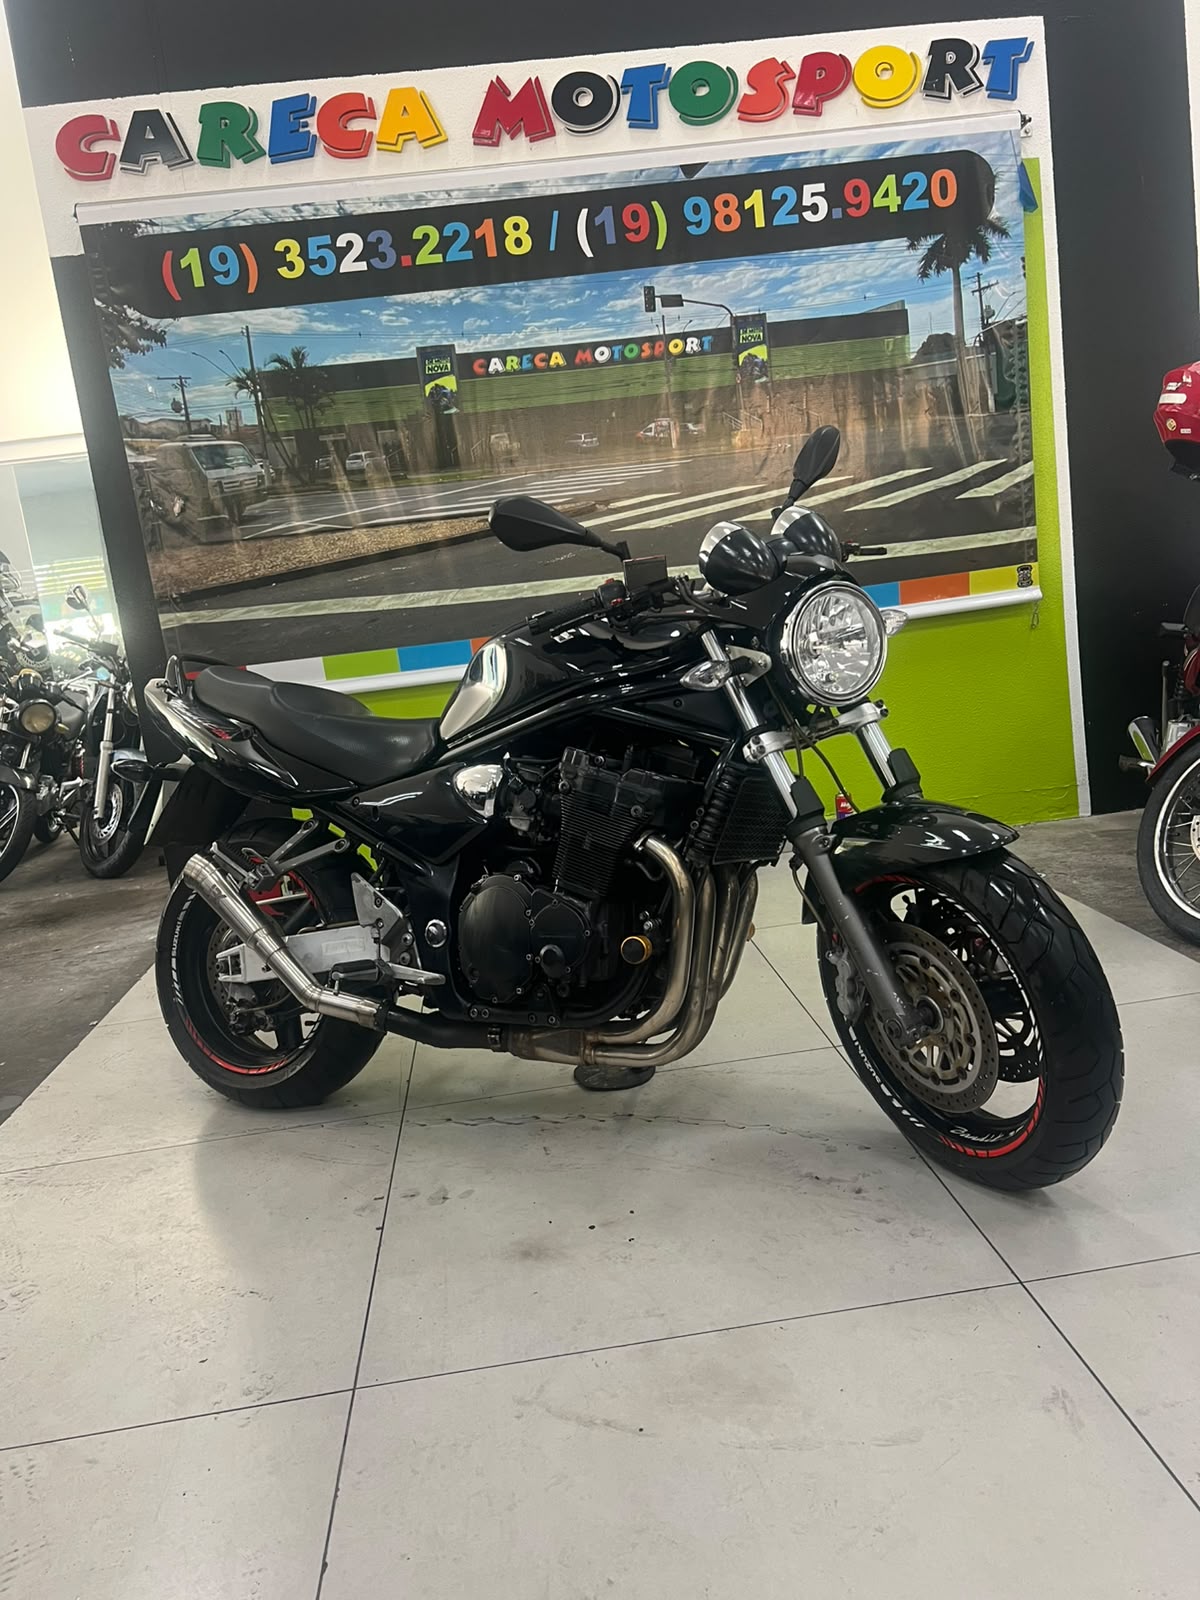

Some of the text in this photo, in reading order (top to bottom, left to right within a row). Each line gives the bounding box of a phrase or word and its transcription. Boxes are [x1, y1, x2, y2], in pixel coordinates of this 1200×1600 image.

[55, 37, 1034, 181] CARECA MOTOSPORT
[162, 168, 958, 300] (19) 3523.2218 / (19) 98125.9420
[472, 335, 713, 375] CARECA MOTOSPORT
[741, 333, 762, 342] NOVA
[427, 364, 449, 373] NOVA
[171, 921, 182, 956] SUZUKI
